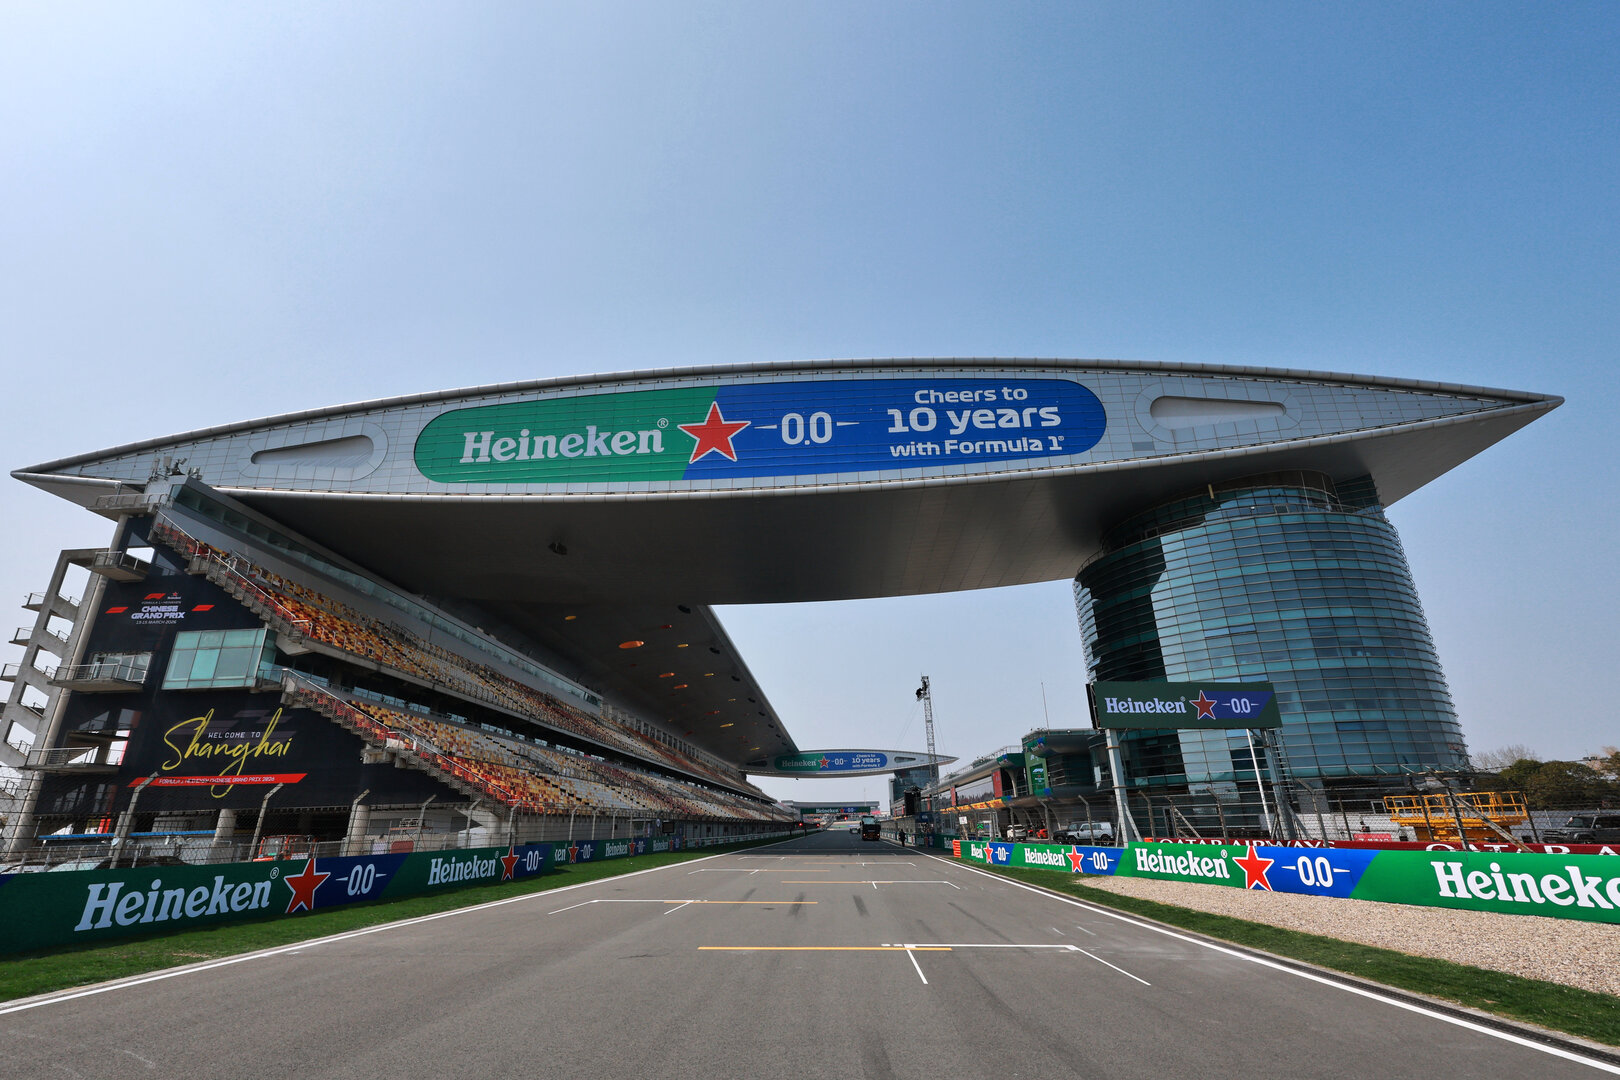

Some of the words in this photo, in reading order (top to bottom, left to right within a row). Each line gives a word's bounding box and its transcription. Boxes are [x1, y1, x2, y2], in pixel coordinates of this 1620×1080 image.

[914, 389, 997, 404] Cheers
[1001, 386, 1028, 401] to
[887, 406, 938, 433] 10
[946, 406, 1062, 435] years
[889, 441, 941, 457] with
[945, 436, 1043, 454] Formula
[161, 707, 293, 798] Shanghai
[605, 842, 628, 857] Heineken
